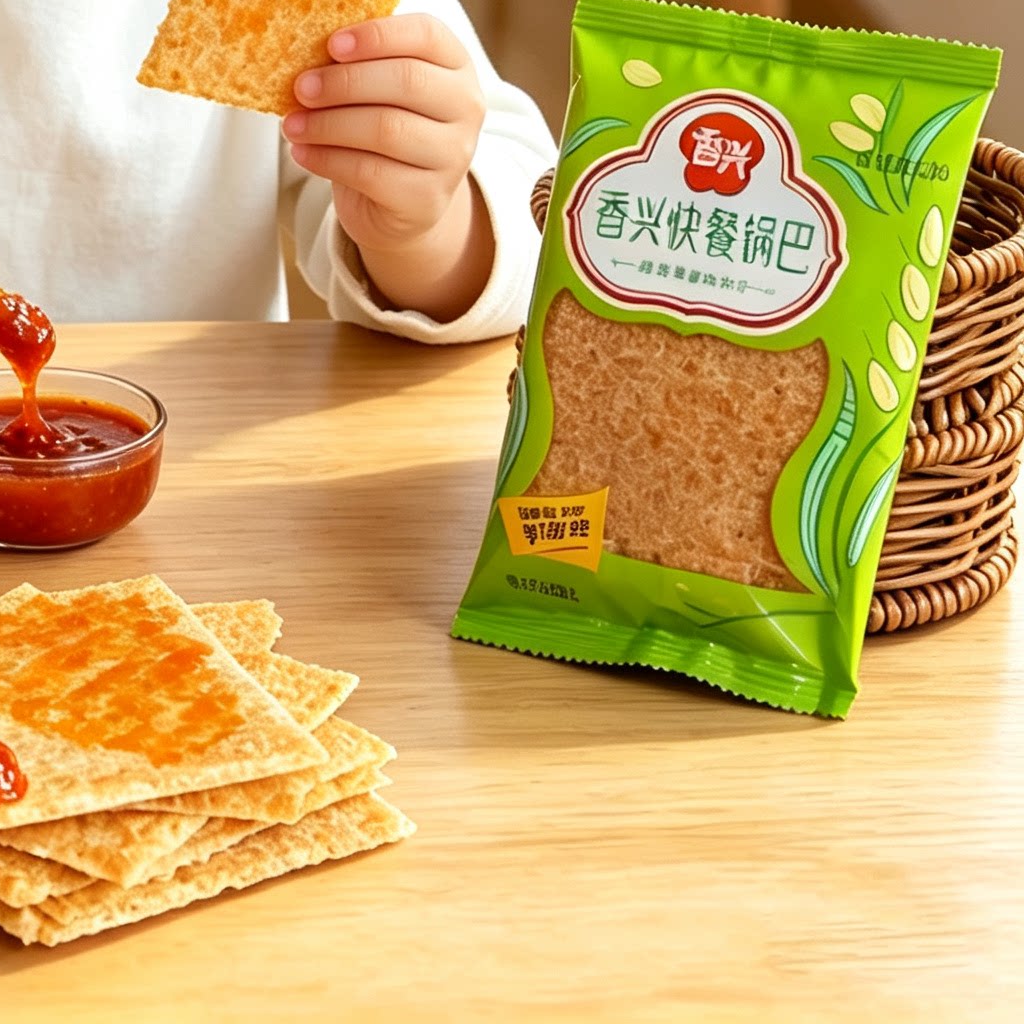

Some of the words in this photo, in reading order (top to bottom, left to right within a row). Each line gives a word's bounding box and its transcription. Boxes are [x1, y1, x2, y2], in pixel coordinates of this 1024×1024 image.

[596, 189, 816, 275] 香兴快餐锅巴
